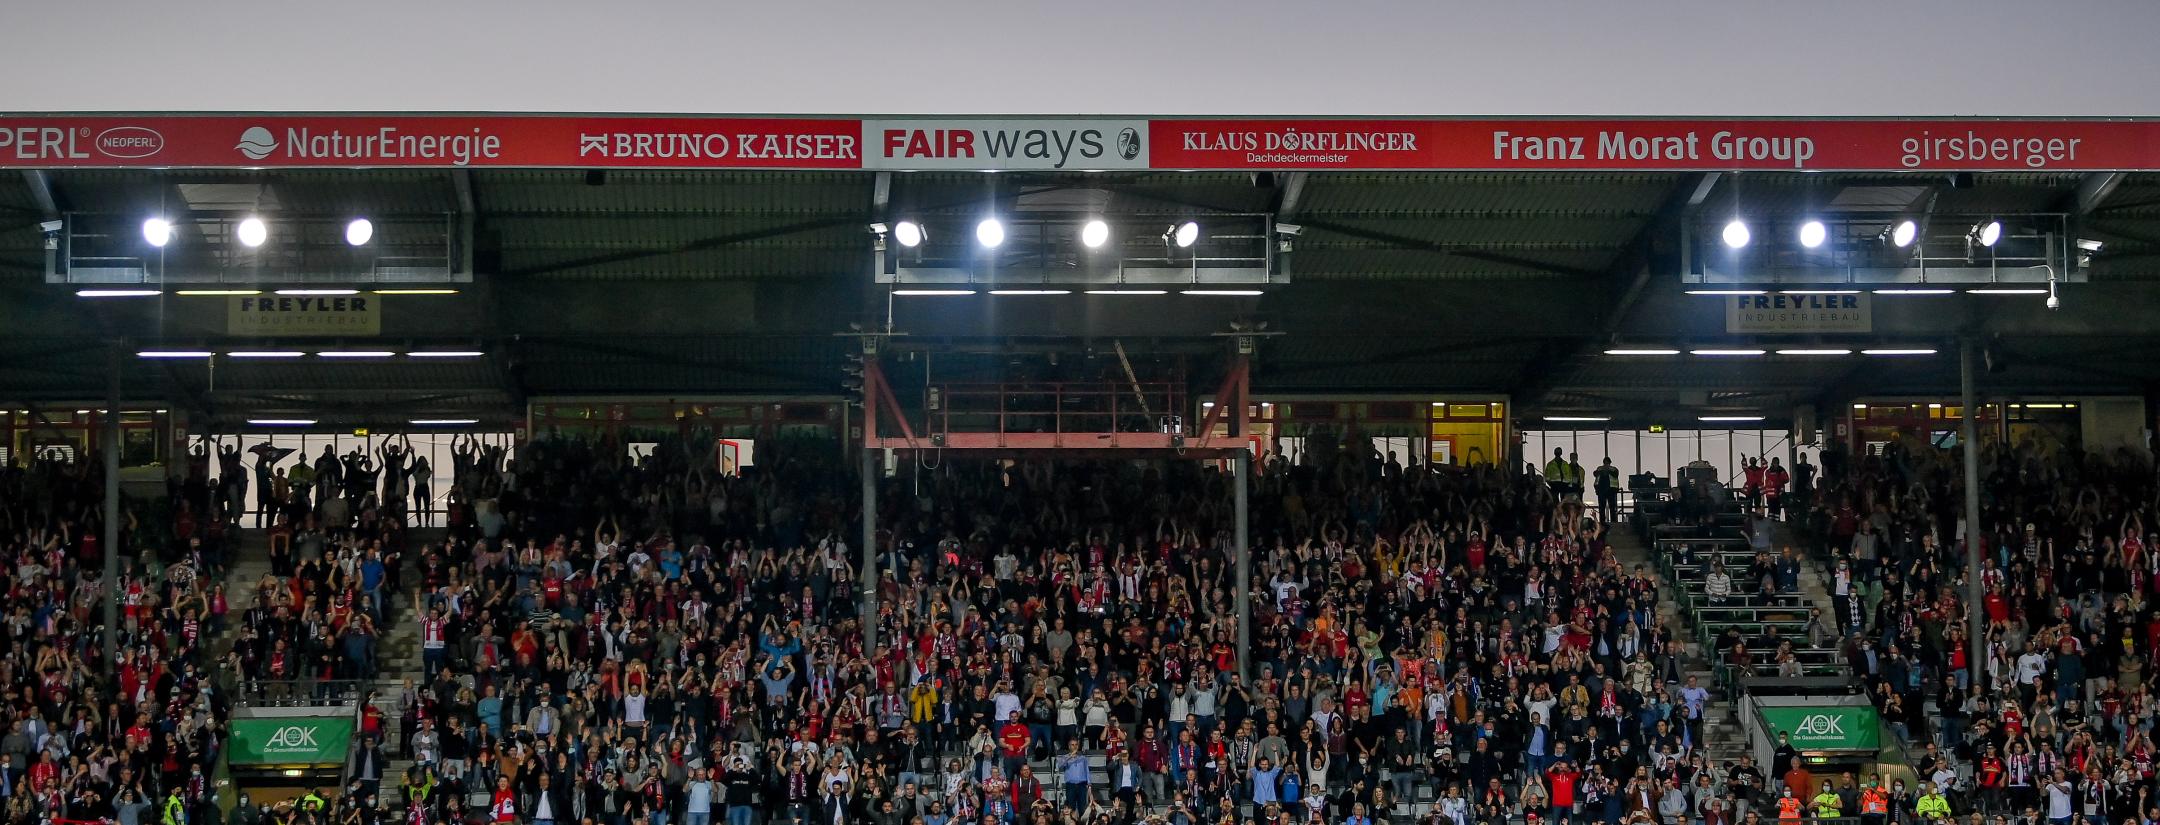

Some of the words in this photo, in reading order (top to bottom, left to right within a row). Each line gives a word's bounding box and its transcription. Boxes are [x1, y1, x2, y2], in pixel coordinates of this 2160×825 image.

[103, 137, 157, 148] NEOPERL
[287, 127, 500, 165] NaturEnergie
[613, 133, 729, 158] BRUNO
[736, 134, 857, 159] KAISER
[883, 129, 975, 158] FAIR
[982, 129, 1104, 168] ways
[1183, 132, 1258, 151] KLAUS
[1265, 127, 1418, 151] DÖRFLINGER
[1493, 131, 1585, 160] Franz
[1597, 131, 1699, 160] Morat
[1711, 131, 1815, 168] Group
[1901, 130, 2081, 168] girsberger
[1247, 153, 1348, 163] Dachdeckermeister
[241, 297, 368, 312] FREYLER
[1738, 295, 1859, 309] FREYLER
[1738, 313, 1860, 322] INDUSTRIEBAU
[1795, 714, 1844, 734] AOK
[266, 726, 318, 747] AOK
